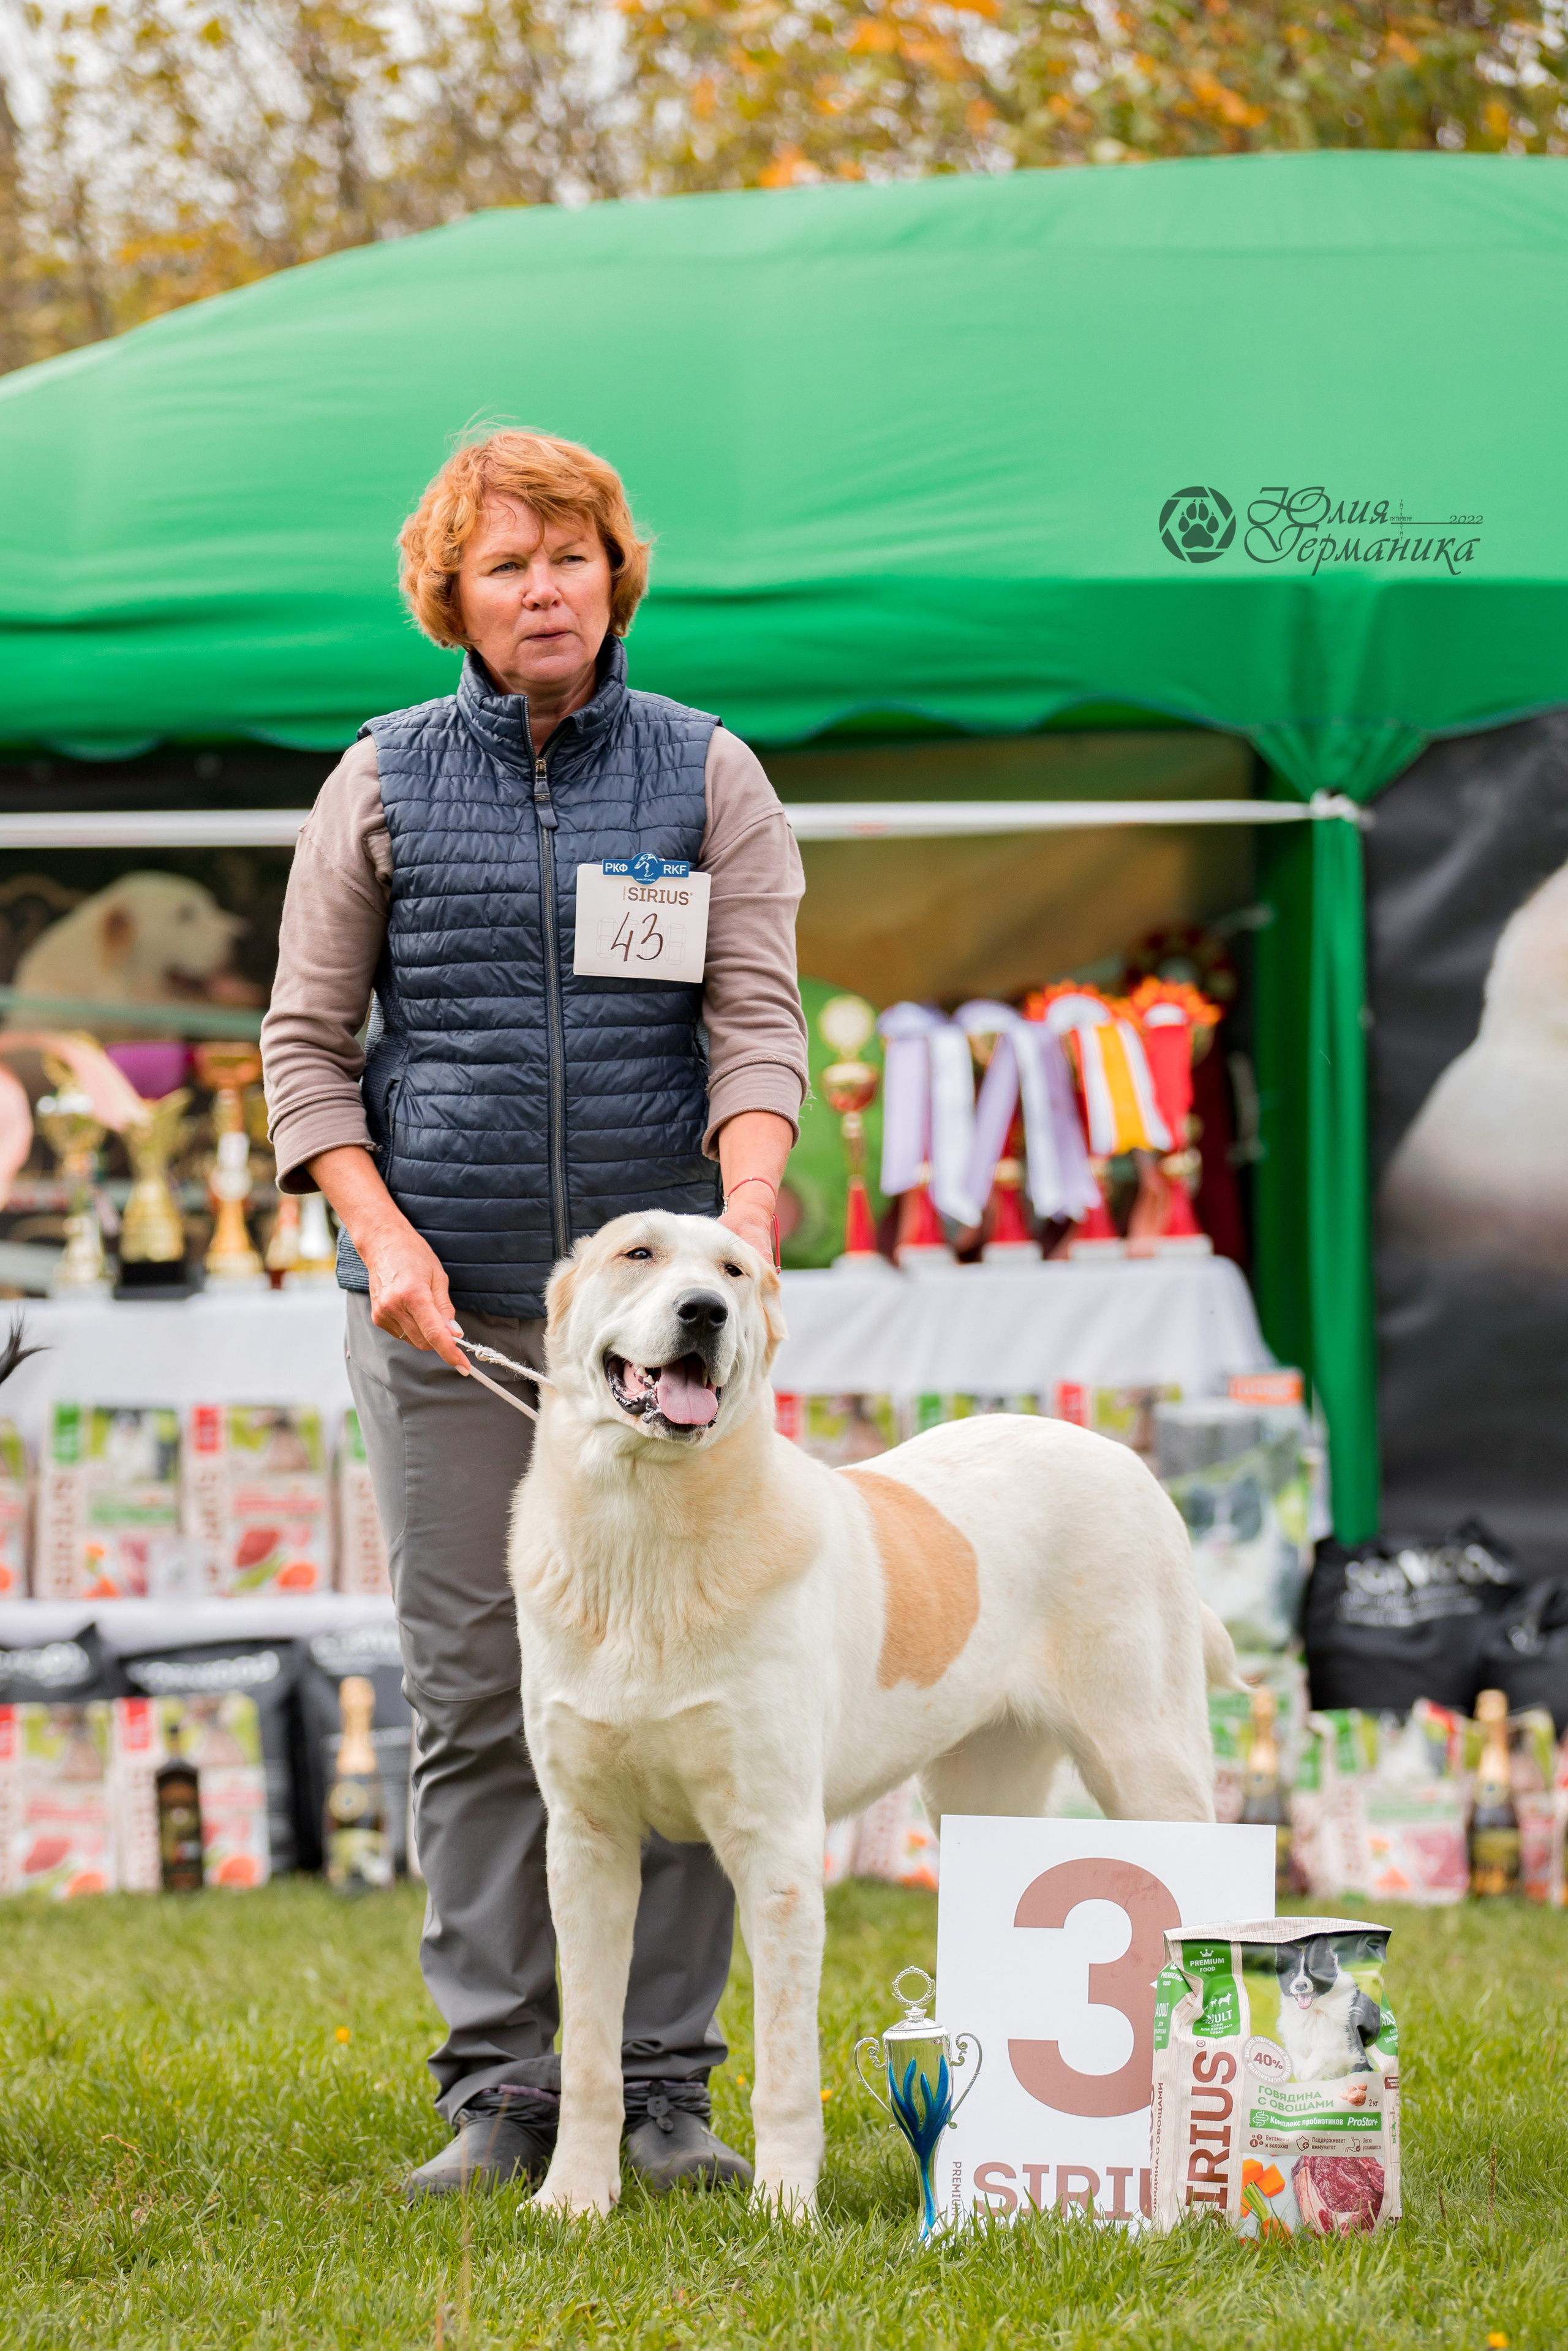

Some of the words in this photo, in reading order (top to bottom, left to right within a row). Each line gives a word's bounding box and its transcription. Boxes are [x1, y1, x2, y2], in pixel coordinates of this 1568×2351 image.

[605, 862, 628, 873] РКФ
[663, 864, 687, 875] RKF
[628, 887, 689, 905] SIRIUS
[610, 911, 663, 962] 43
[1190, 1958, 1224, 1967] PREMIUM
[1161, 1972, 1183, 1982] PREMIUM
[1008, 1857, 1182, 2118] 3
[1155, 2002, 1169, 2017] ADULT
[1245, 2037, 1256, 2058] ВЫСОКОЕ
[1254, 2037, 1286, 2056] СОДЕРЖАНИЕ
[1253, 2052, 1283, 2069] 40%
[1259, 2085, 1322, 2102] ГОВЯДИНА
[1269, 2100, 1334, 2112] ОВОЩАМИ
[1270, 2116, 1301, 2127] Комплекс
[1302, 2118, 1343, 2126] пробиотиков
[1348, 2117, 1378, 2127] ProStor+
[1185, 2050, 1237, 2230] IRIUS
